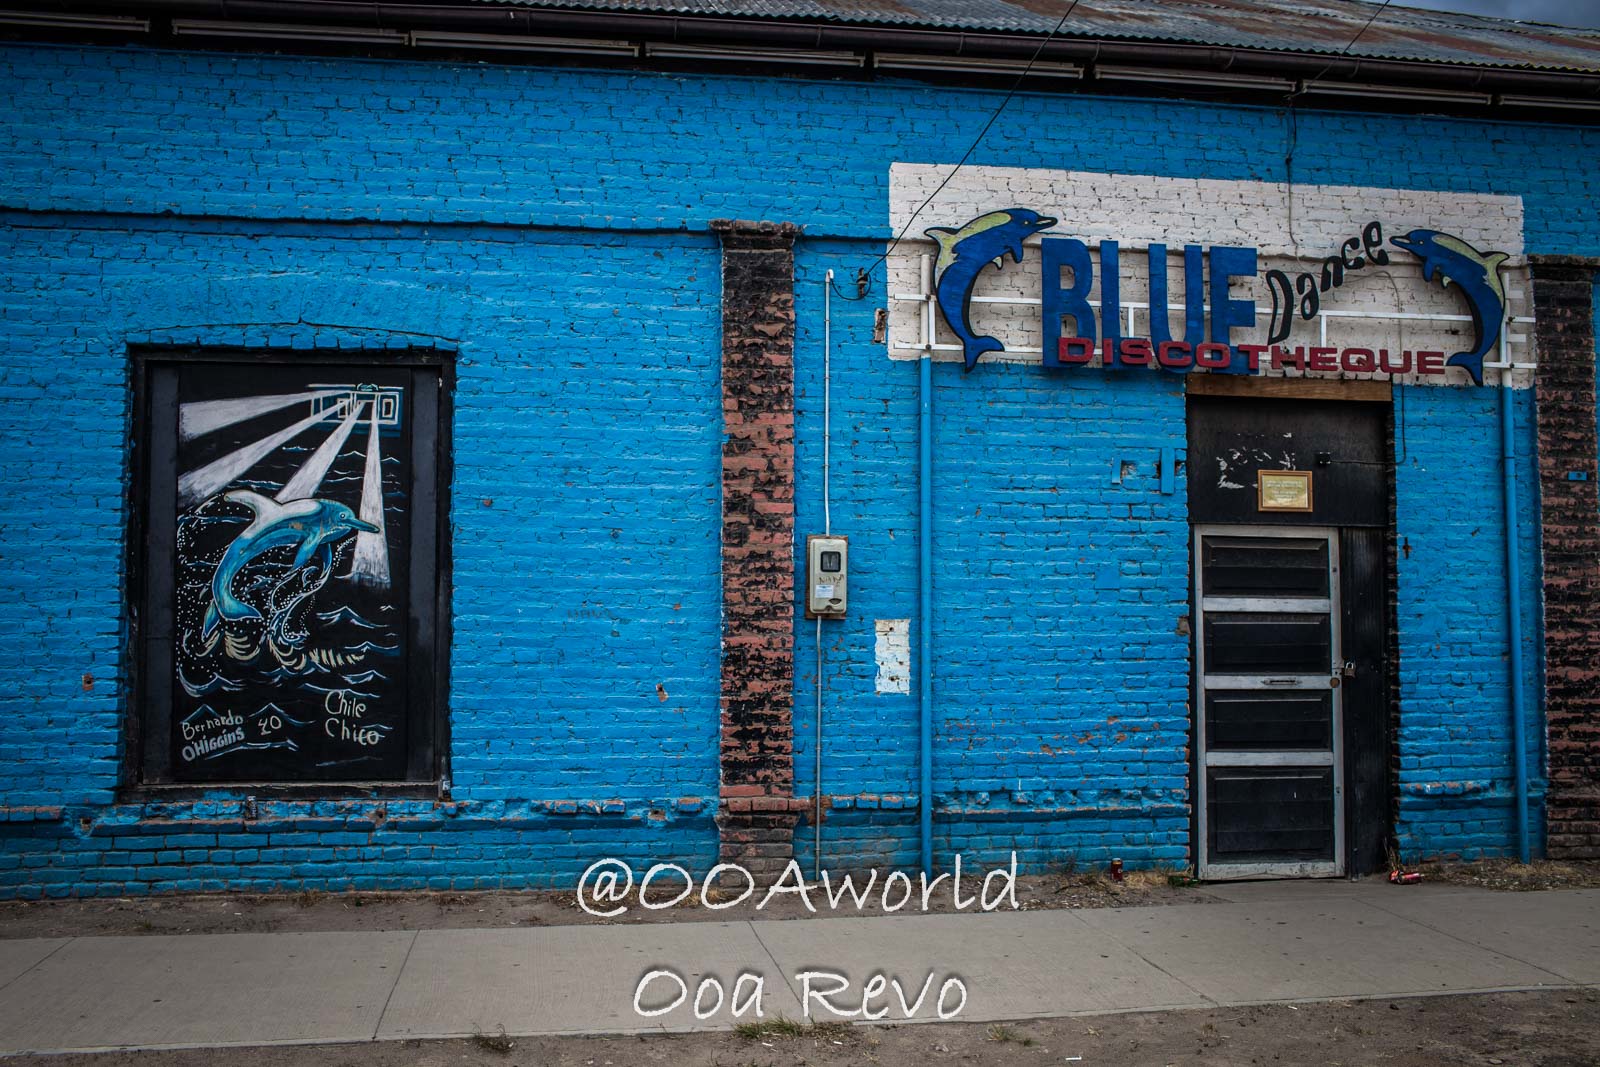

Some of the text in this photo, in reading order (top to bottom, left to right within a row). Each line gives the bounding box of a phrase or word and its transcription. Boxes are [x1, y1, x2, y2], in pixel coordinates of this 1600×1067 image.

[1266, 221, 1389, 345] Dance
[1041, 238, 1260, 374] BLUE
[1058, 336, 1446, 375] DISCOTHEQUE
[325, 689, 366, 718] Chile
[182, 709, 244, 741] Bernardo
[325, 718, 380, 746] Chico
